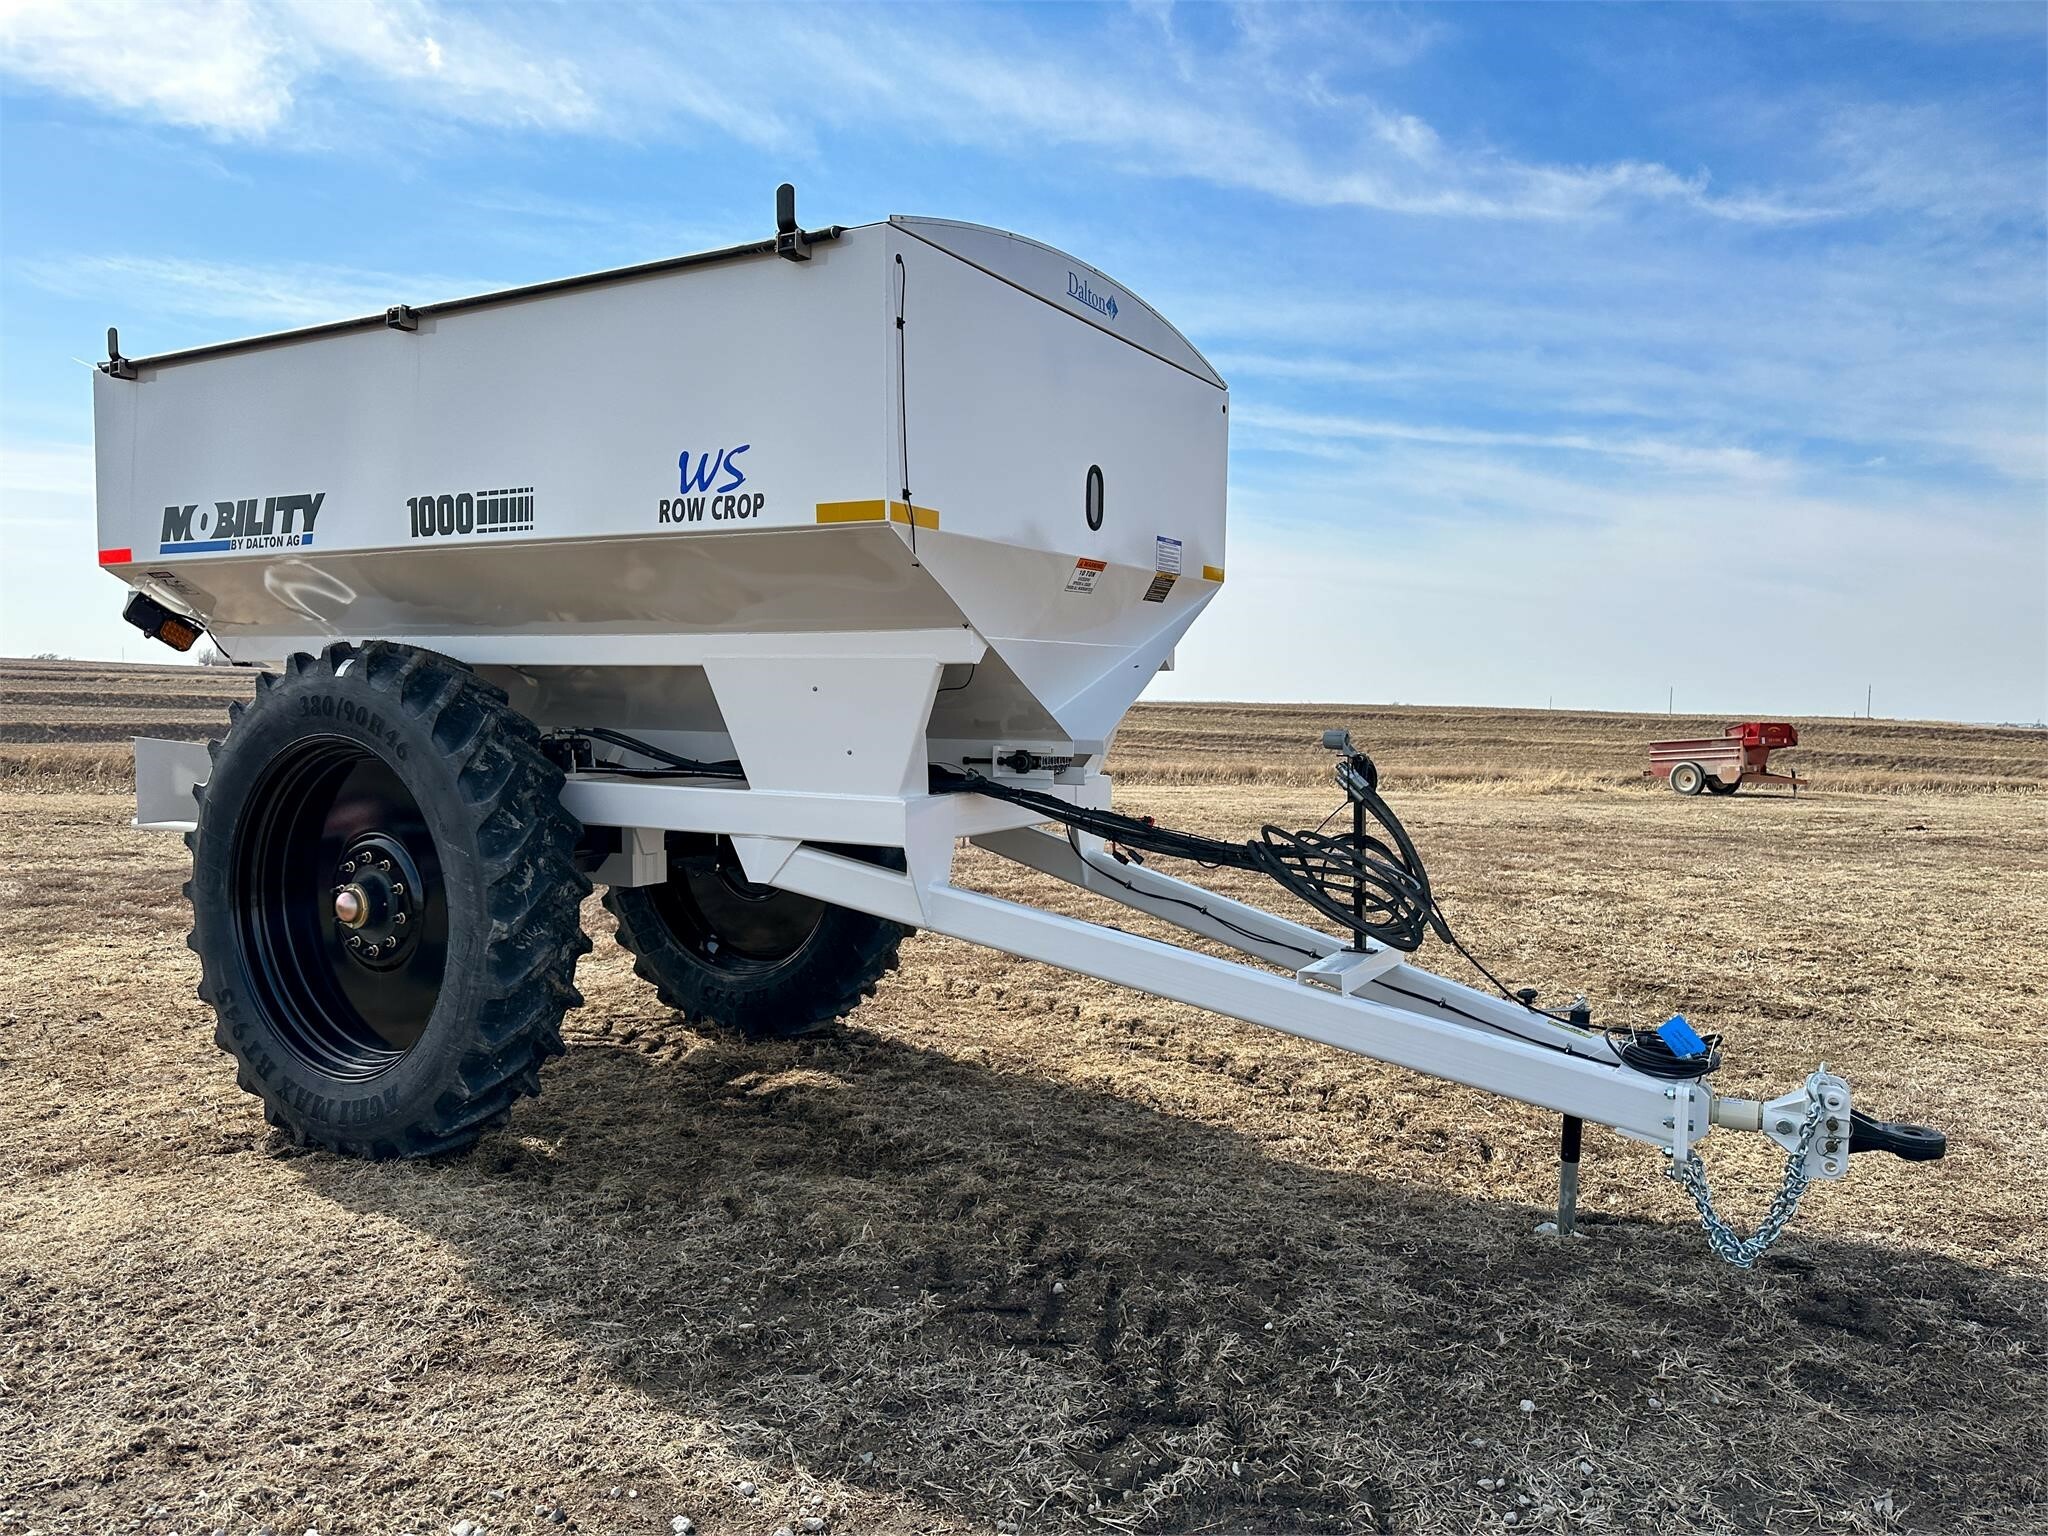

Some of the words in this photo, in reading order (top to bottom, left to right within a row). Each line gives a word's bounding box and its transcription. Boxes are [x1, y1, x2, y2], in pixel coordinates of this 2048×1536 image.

[1067, 271, 1106, 313] Dalton
[678, 444, 750, 495] WS
[161, 492, 326, 542] MOBILITY
[407, 492, 474, 538] 1000
[659, 496, 706, 524] ROW
[711, 492, 765, 521] CROP
[231, 539, 244, 551] BY
[246, 535, 284, 550] DALTON
[286, 534, 300, 547] AG
[1086, 570, 1096, 578] TON
